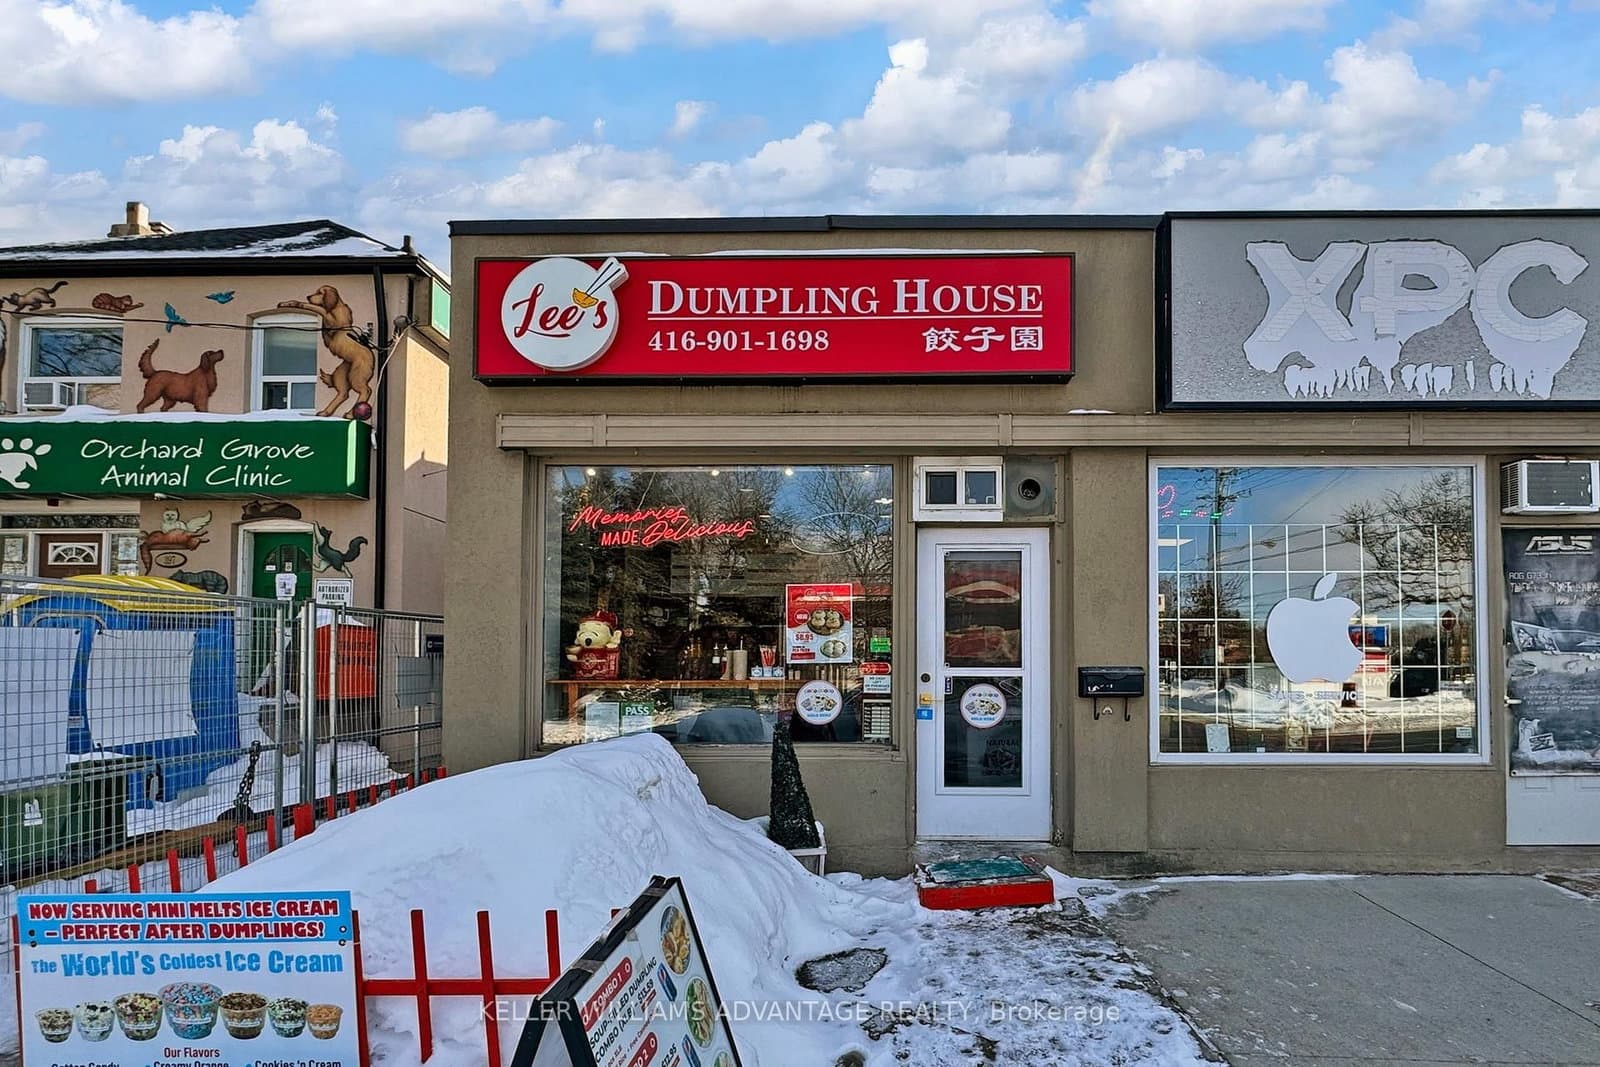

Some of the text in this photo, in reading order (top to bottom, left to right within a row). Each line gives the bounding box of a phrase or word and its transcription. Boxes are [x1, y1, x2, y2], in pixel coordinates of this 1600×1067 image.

[647, 278, 1043, 315] DUMPLING HOUSE
[1243, 238, 1590, 358] XPC
[511, 282, 609, 338] Lee's
[648, 330, 829, 351] 416-901-1698
[922, 326, 1043, 352] 餃子園
[80, 438, 314, 460] Orchard Grove
[100, 464, 292, 487] Animal Clinic
[569, 505, 688, 532] Memories
[600, 518, 756, 548] MADE Delicious
[1525, 535, 1593, 552] ASUS
[625, 706, 650, 716] PASS
[29, 900, 338, 920] NOW SERVING MINI MELTS ICE CREAM
[61, 924, 141, 940] PERFECT
[145, 923, 205, 939] AFTER
[208, 921, 324, 939] DUMPLINGS!
[31, 950, 343, 977] The World's Coldest Ice Cream
[628, 956, 657, 996] DUMPLING
[163, 1047, 221, 1058] Our Flavors
[594, 1026, 619, 1064] COMBO
